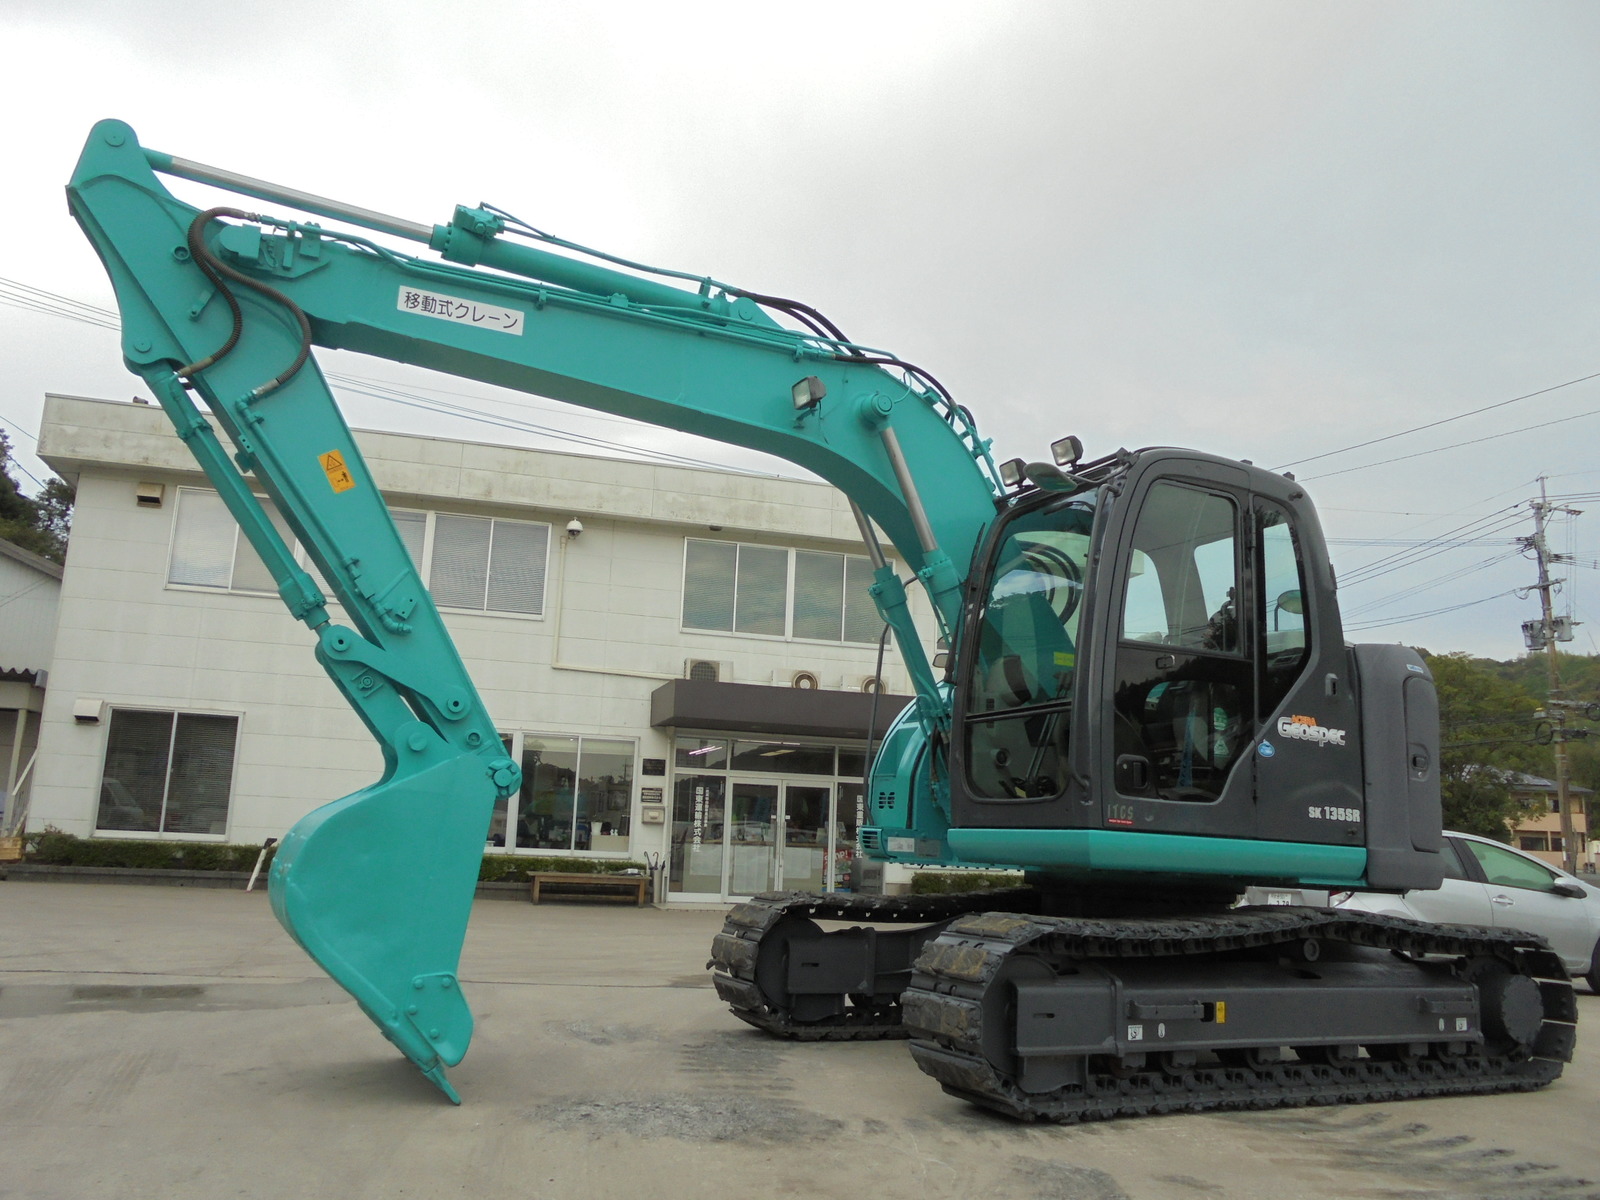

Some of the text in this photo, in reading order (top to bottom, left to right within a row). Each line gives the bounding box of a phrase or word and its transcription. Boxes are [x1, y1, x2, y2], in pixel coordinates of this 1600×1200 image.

[403, 291, 518, 329] 移動式クレーン
[1308, 806, 1361, 823] SK 135SR
